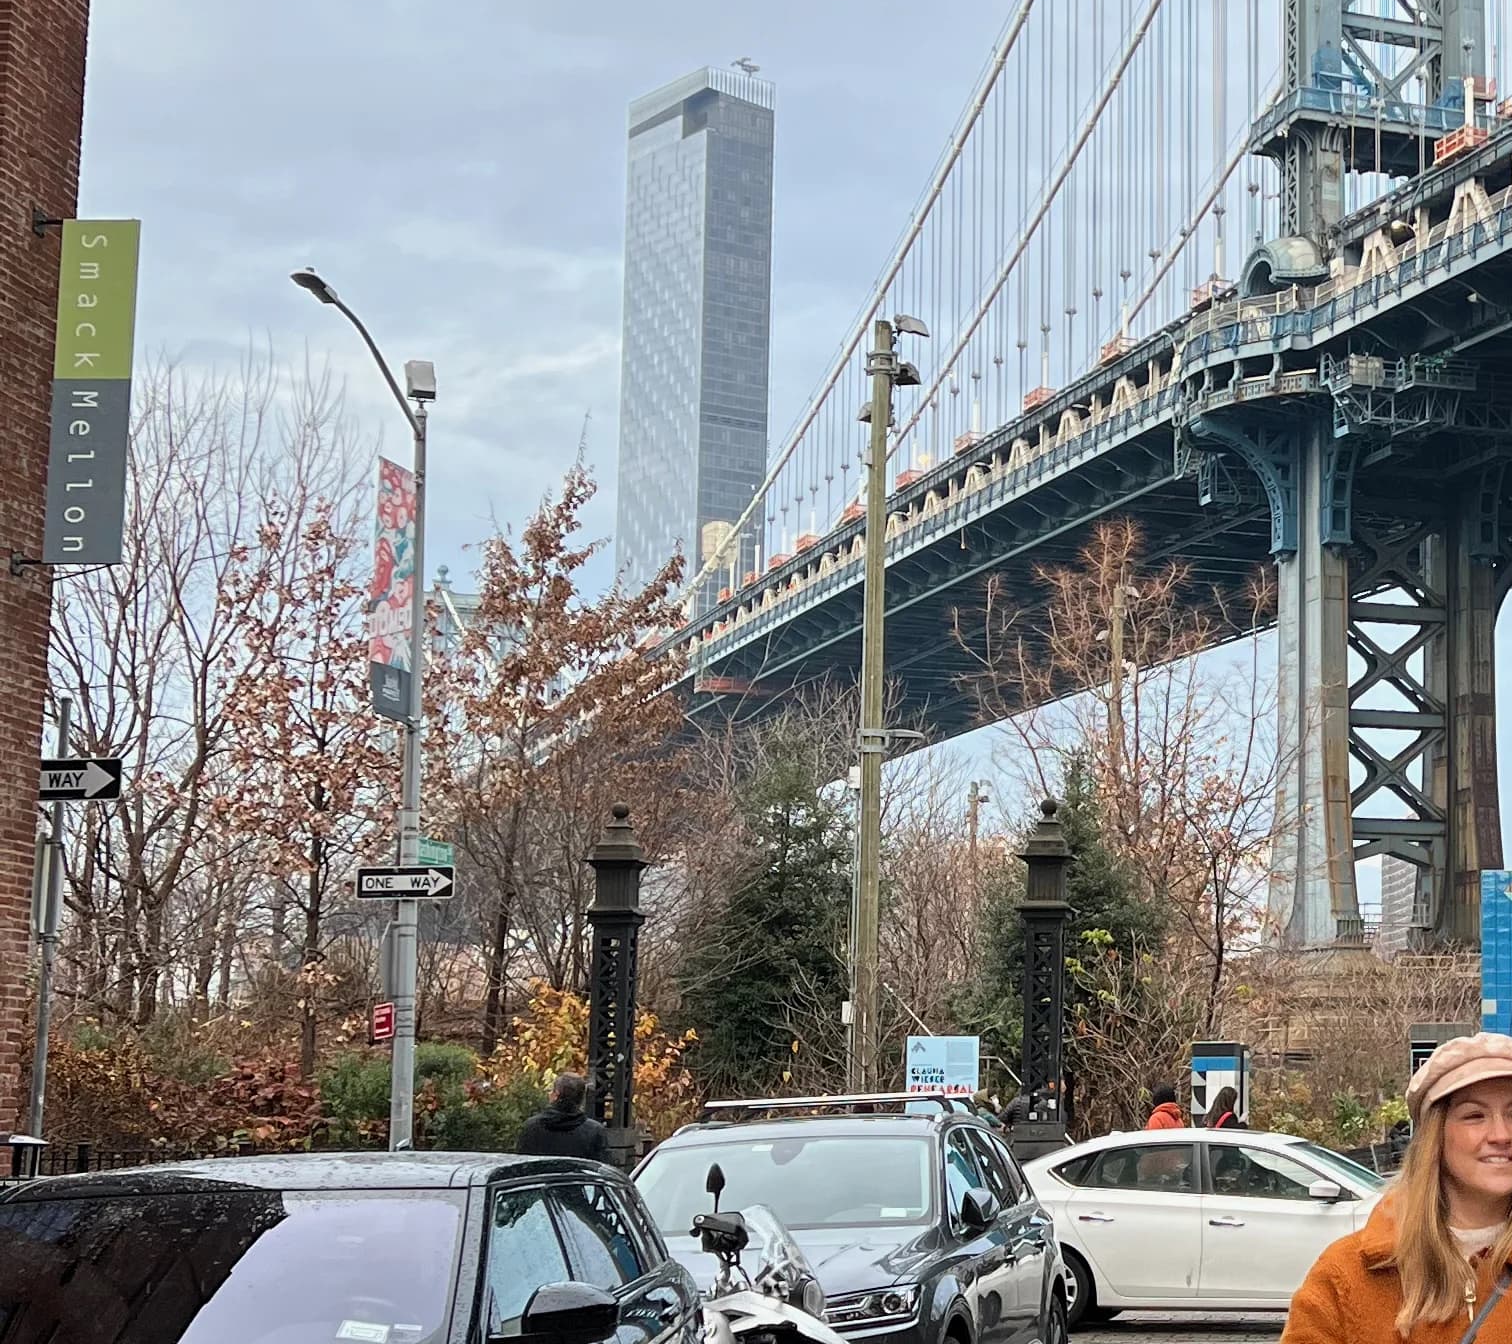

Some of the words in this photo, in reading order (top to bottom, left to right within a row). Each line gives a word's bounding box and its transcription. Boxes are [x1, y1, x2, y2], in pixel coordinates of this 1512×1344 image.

[73, 234, 108, 367] Smack
[62, 391, 98, 552] Mellon
[49, 772, 84, 788] WAY
[365, 877, 394, 889] ONE
[410, 876, 440, 889] WAY
